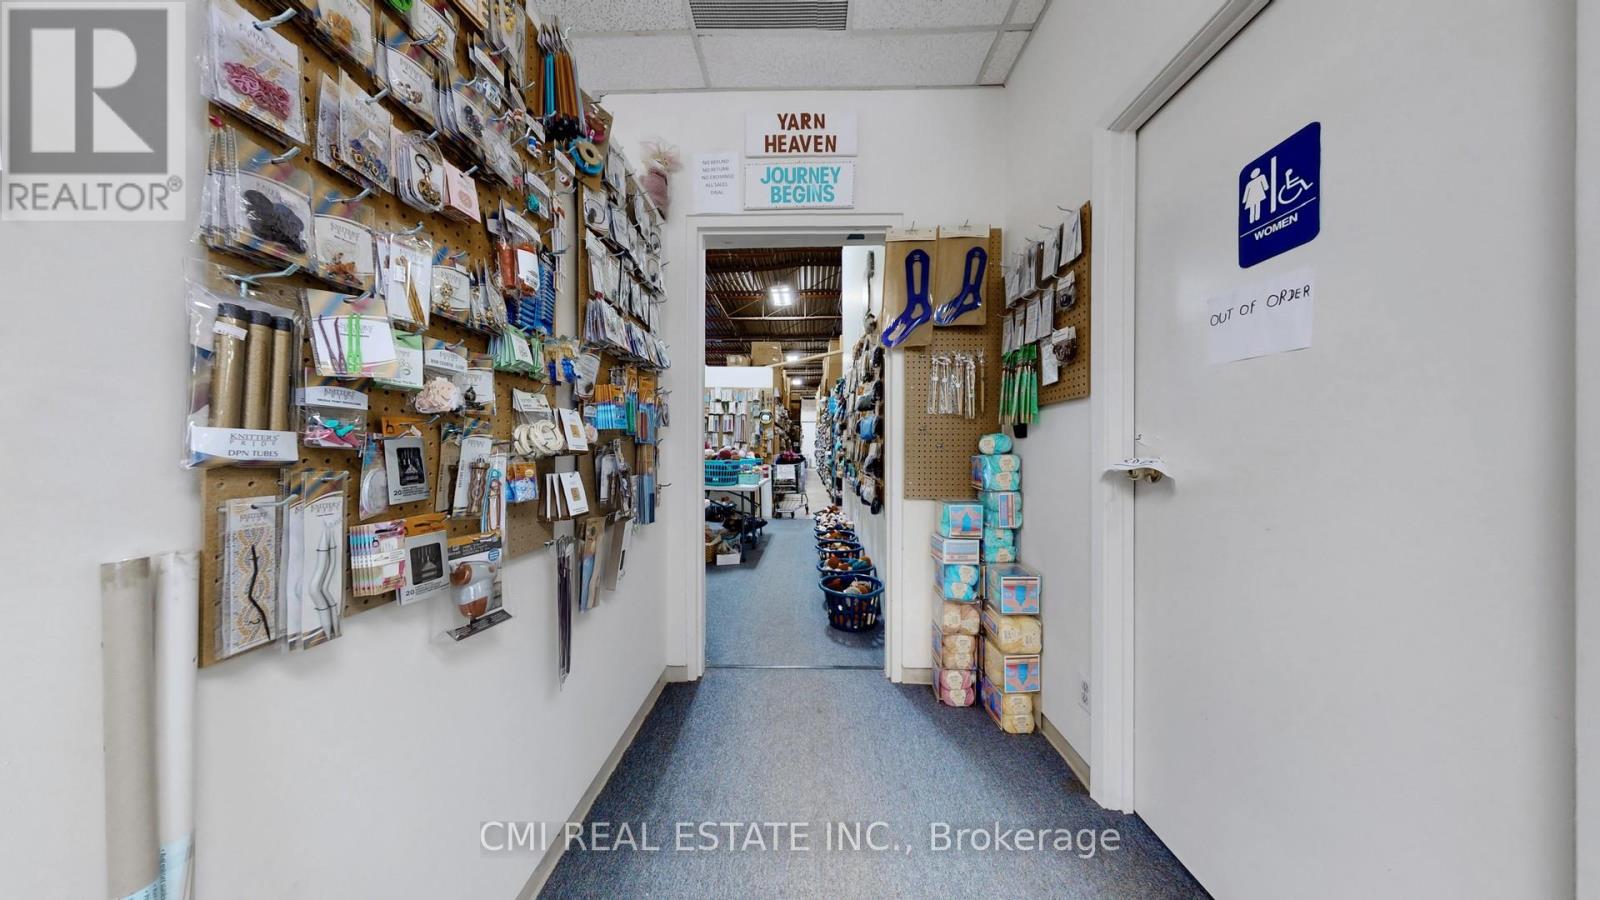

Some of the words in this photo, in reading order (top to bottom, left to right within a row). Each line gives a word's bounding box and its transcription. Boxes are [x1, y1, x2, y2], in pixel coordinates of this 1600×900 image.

[777, 112, 826, 131] YARN
[764, 134, 837, 153] HEAVEN
[760, 166, 841, 185] JOURNEY
[770, 184, 835, 204] BEGINS
[1254, 212, 1298, 241] WOMEN
[1209, 307, 1234, 327] OUT
[1239, 300, 1257, 316] OF
[1266, 284, 1311, 308] ORDER
[228, 449, 249, 457] DPN
[253, 449, 279, 457] TUBES
